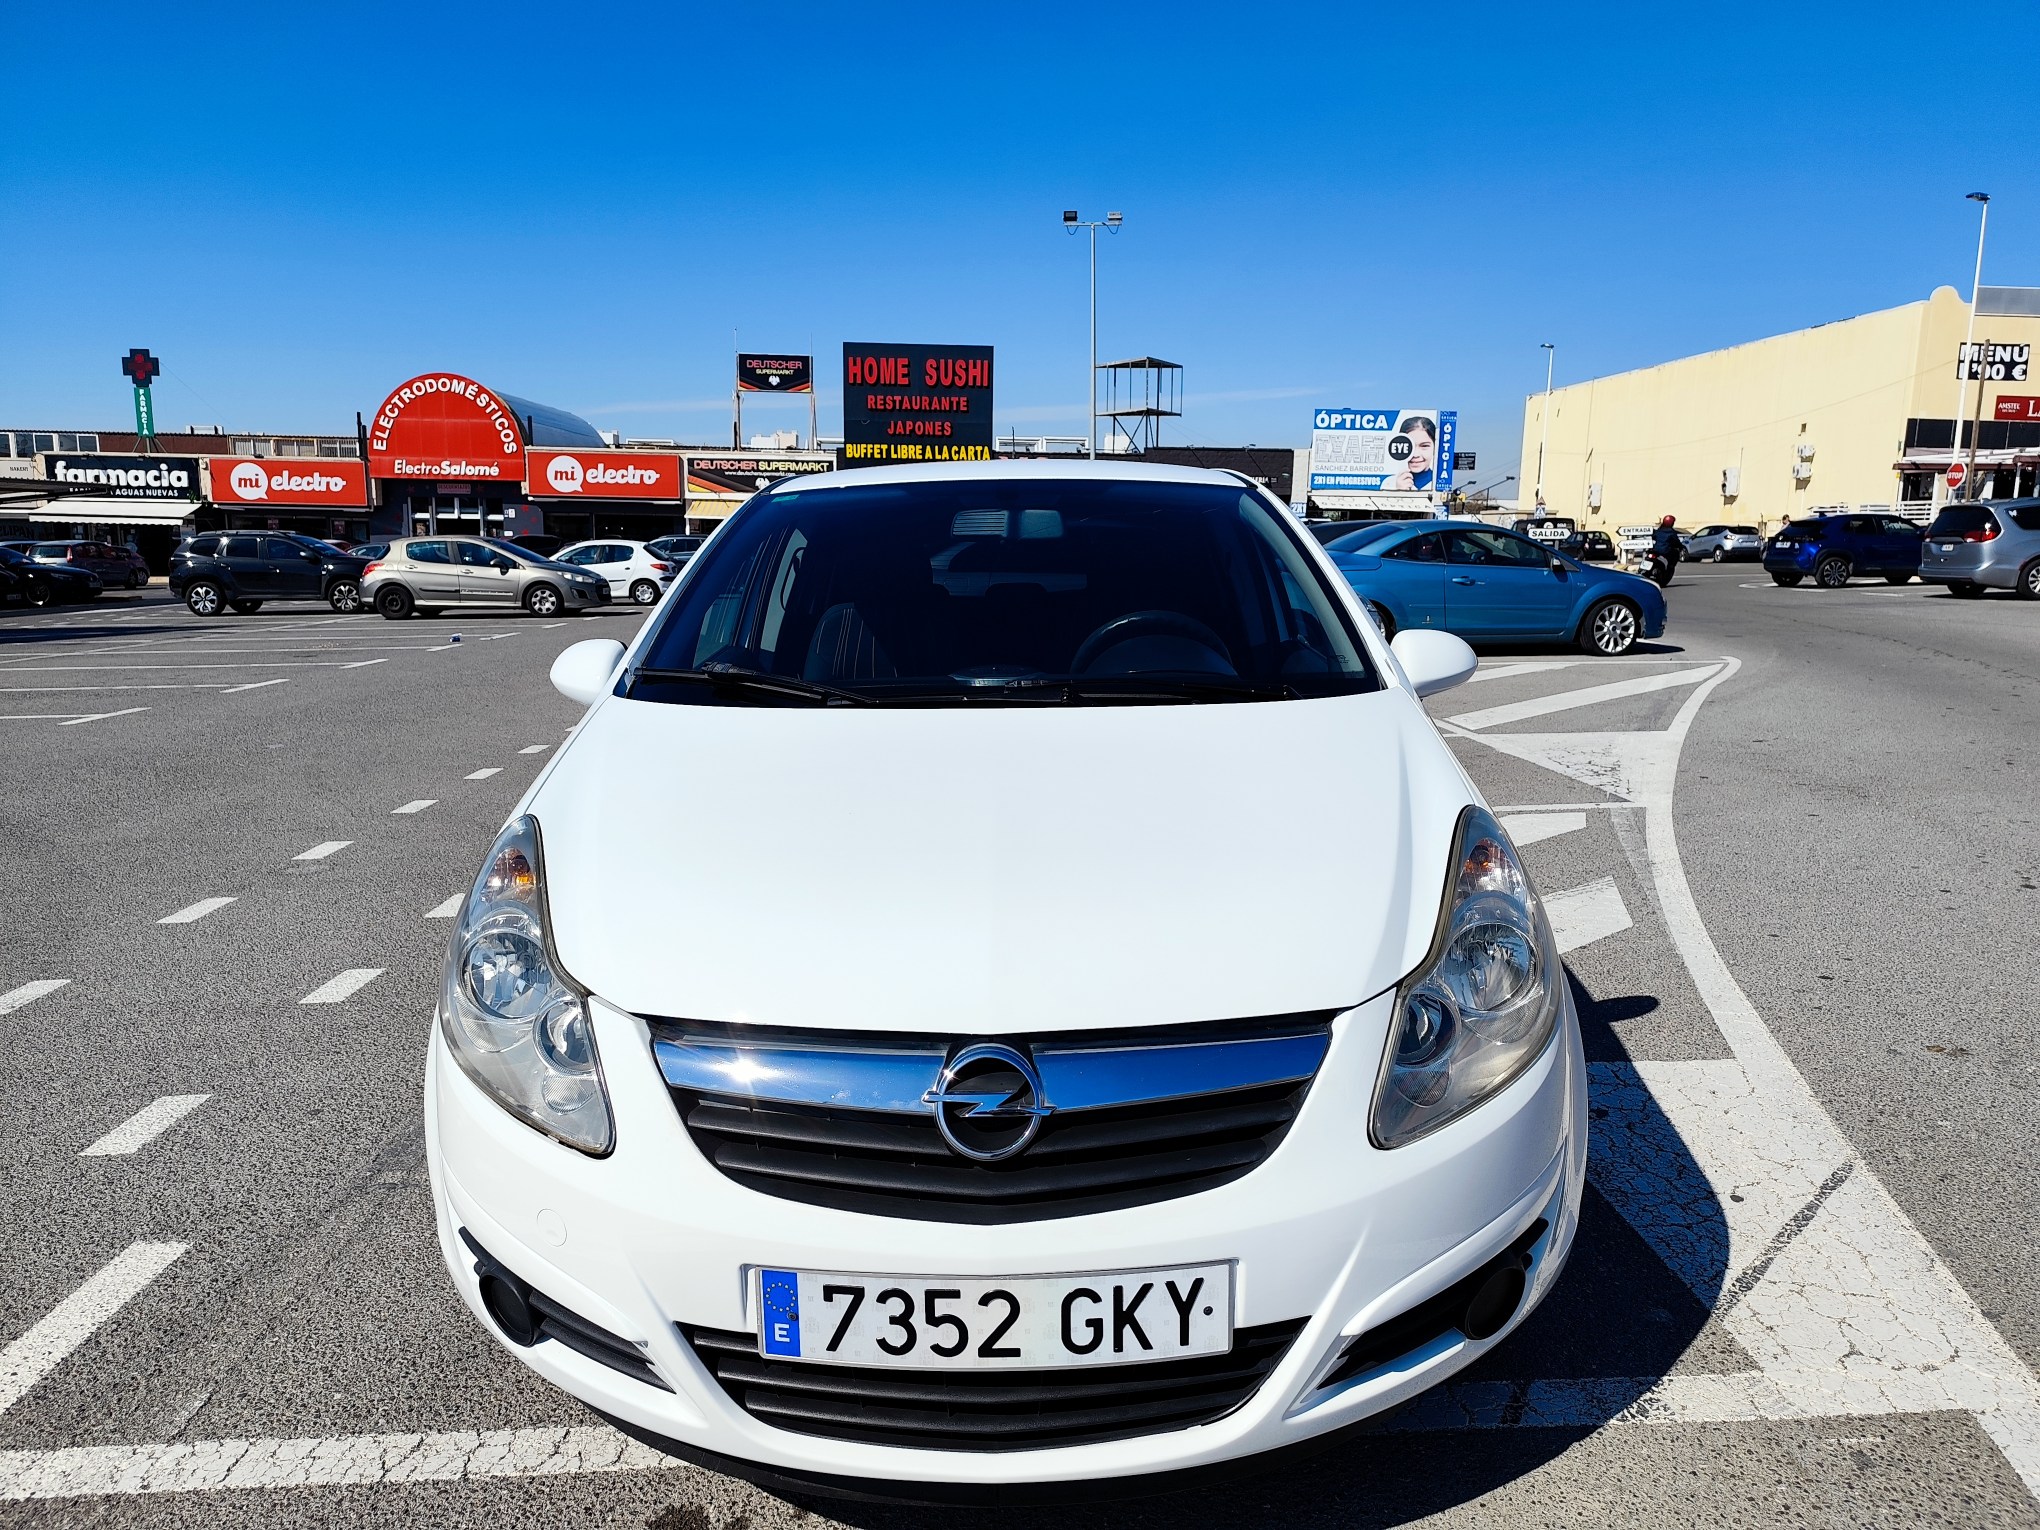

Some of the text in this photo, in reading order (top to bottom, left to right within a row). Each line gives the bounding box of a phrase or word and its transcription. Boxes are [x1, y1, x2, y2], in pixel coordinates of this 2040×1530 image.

[1960, 343, 2030, 363] MENÚ
[746, 359, 803, 370] DEUTSCHER
[848, 356, 989, 387] HOME SUSHI
[139, 388, 149, 435] FARMACIA
[867, 394, 968, 411] RESTAURANTE
[1998, 402, 2021, 410] AMSTEL
[373, 377, 518, 454] ELECTRODOMÉSTICOS
[1315, 410, 1389, 429] ÓPTICA
[887, 420, 952, 436] JAPONES
[846, 443, 991, 461] BUFFET LIBRE A LA CARTA
[1391, 442, 1409, 454] EYE
[55, 460, 189, 488] farmacia
[394, 459, 500, 477] ElectroSalomé
[554, 463, 661, 485] mi electro
[694, 459, 829, 473] DEUTSCHER SUPERMARKT
[1350, 465, 1385, 473] BARREDO
[1947, 471, 1963, 479] STOP
[238, 470, 347, 492] mi electro
[1326, 476, 1335, 485] EN
[1336, 475, 1381, 486] PROGRESIVOS
[115, 488, 144, 497] AGUAS
[145, 488, 179, 497] NUEVAS
[822, 1277, 1205, 1359] 7352 GKY
[774, 1323, 790, 1343] E
